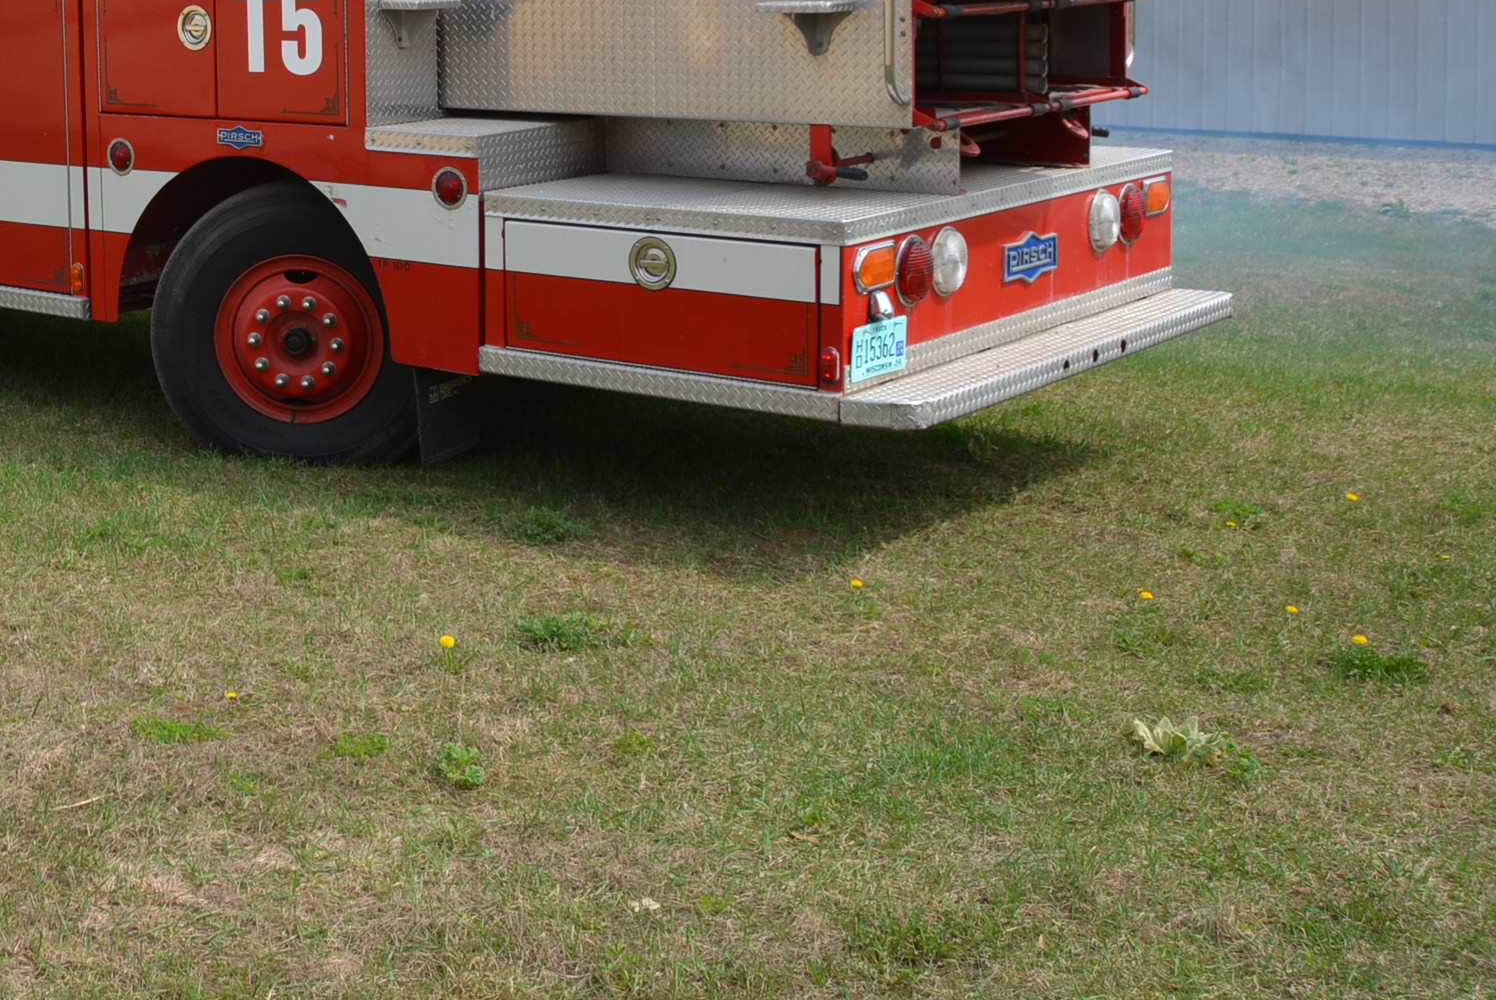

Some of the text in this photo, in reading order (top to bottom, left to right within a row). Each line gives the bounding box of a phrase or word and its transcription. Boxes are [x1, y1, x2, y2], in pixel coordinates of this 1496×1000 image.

[219, 131, 259, 142] PIRSCH
[377, 259, 411, 272] TP 100
[1010, 242, 1054, 272] PIRSCH
[864, 331, 895, 364] 15362
